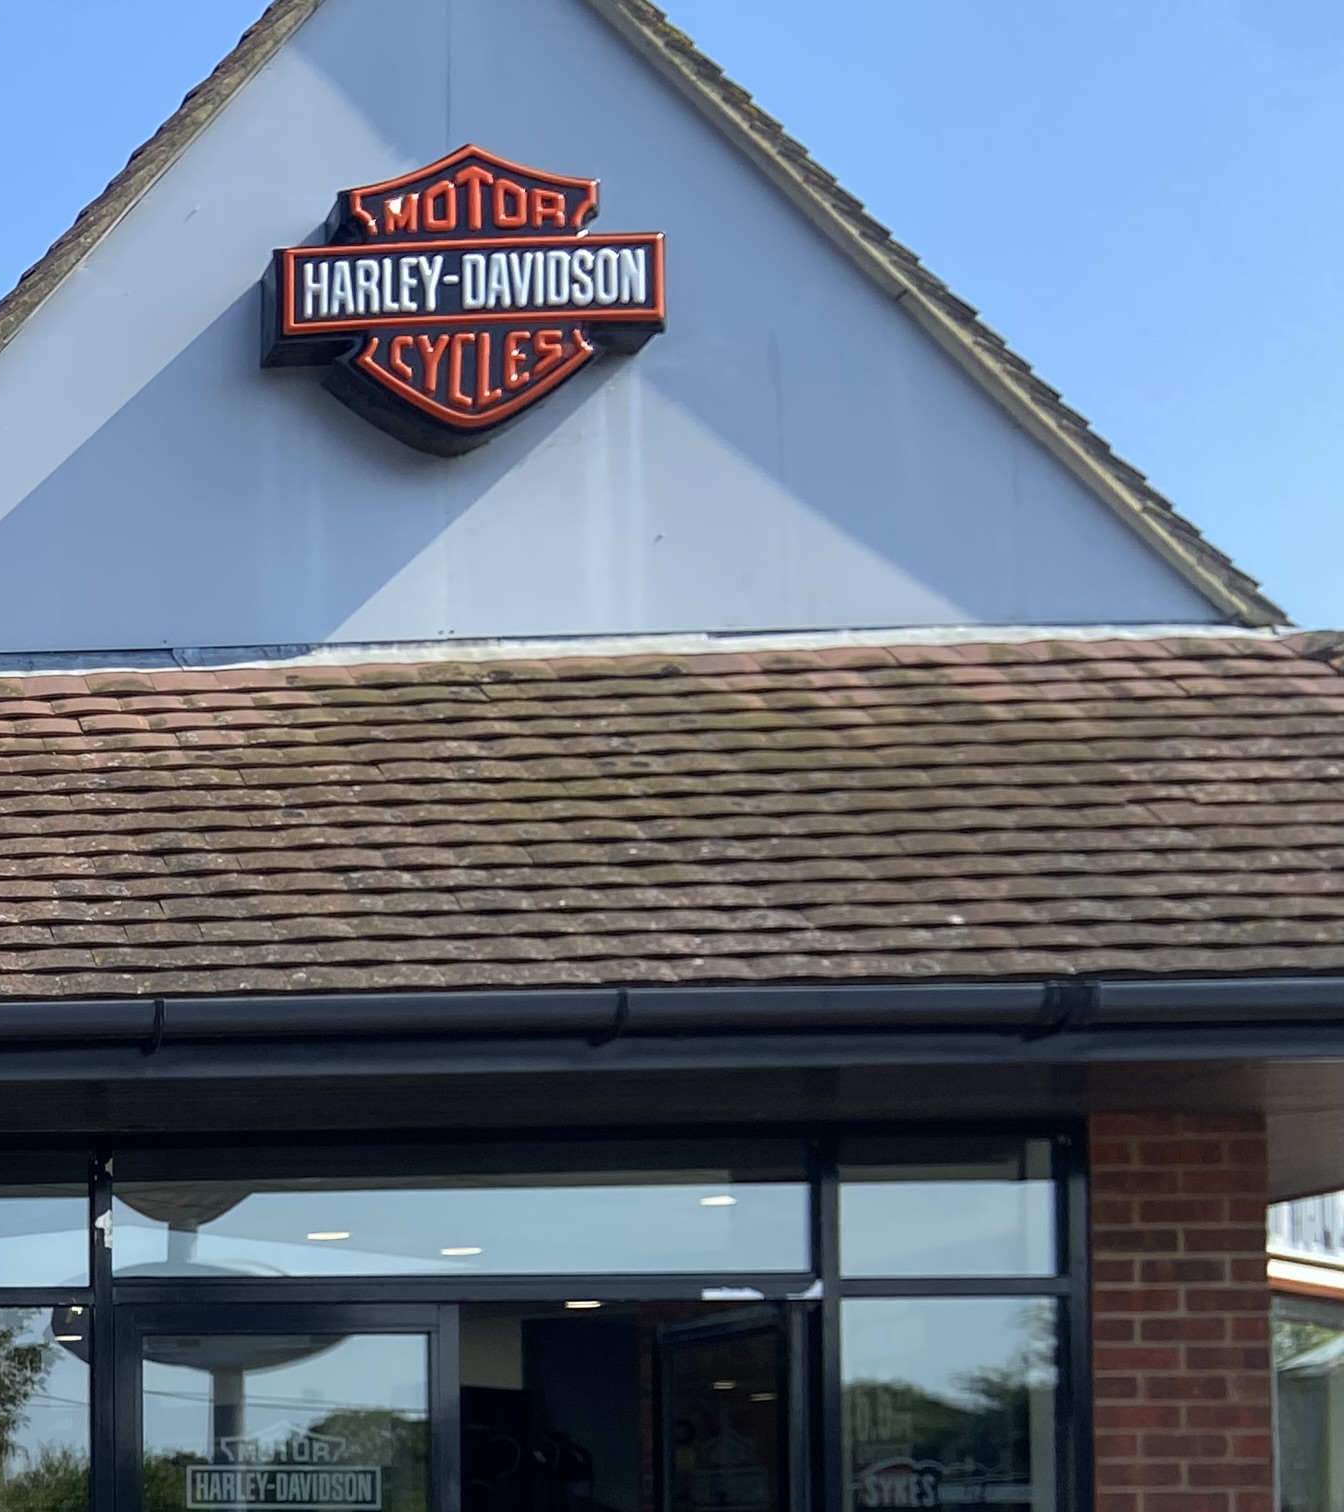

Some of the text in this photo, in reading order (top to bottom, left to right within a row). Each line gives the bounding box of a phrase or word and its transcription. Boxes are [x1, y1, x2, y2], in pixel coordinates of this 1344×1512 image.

[383, 165, 566, 235] MOTOR
[303, 247, 647, 319] HARLEY-DAVIDSON
[388, 329, 564, 409] CYCLES
[195, 1472, 373, 1502] HARLEY-DAVIDSON
[864, 1474, 937, 1508] SYKES
